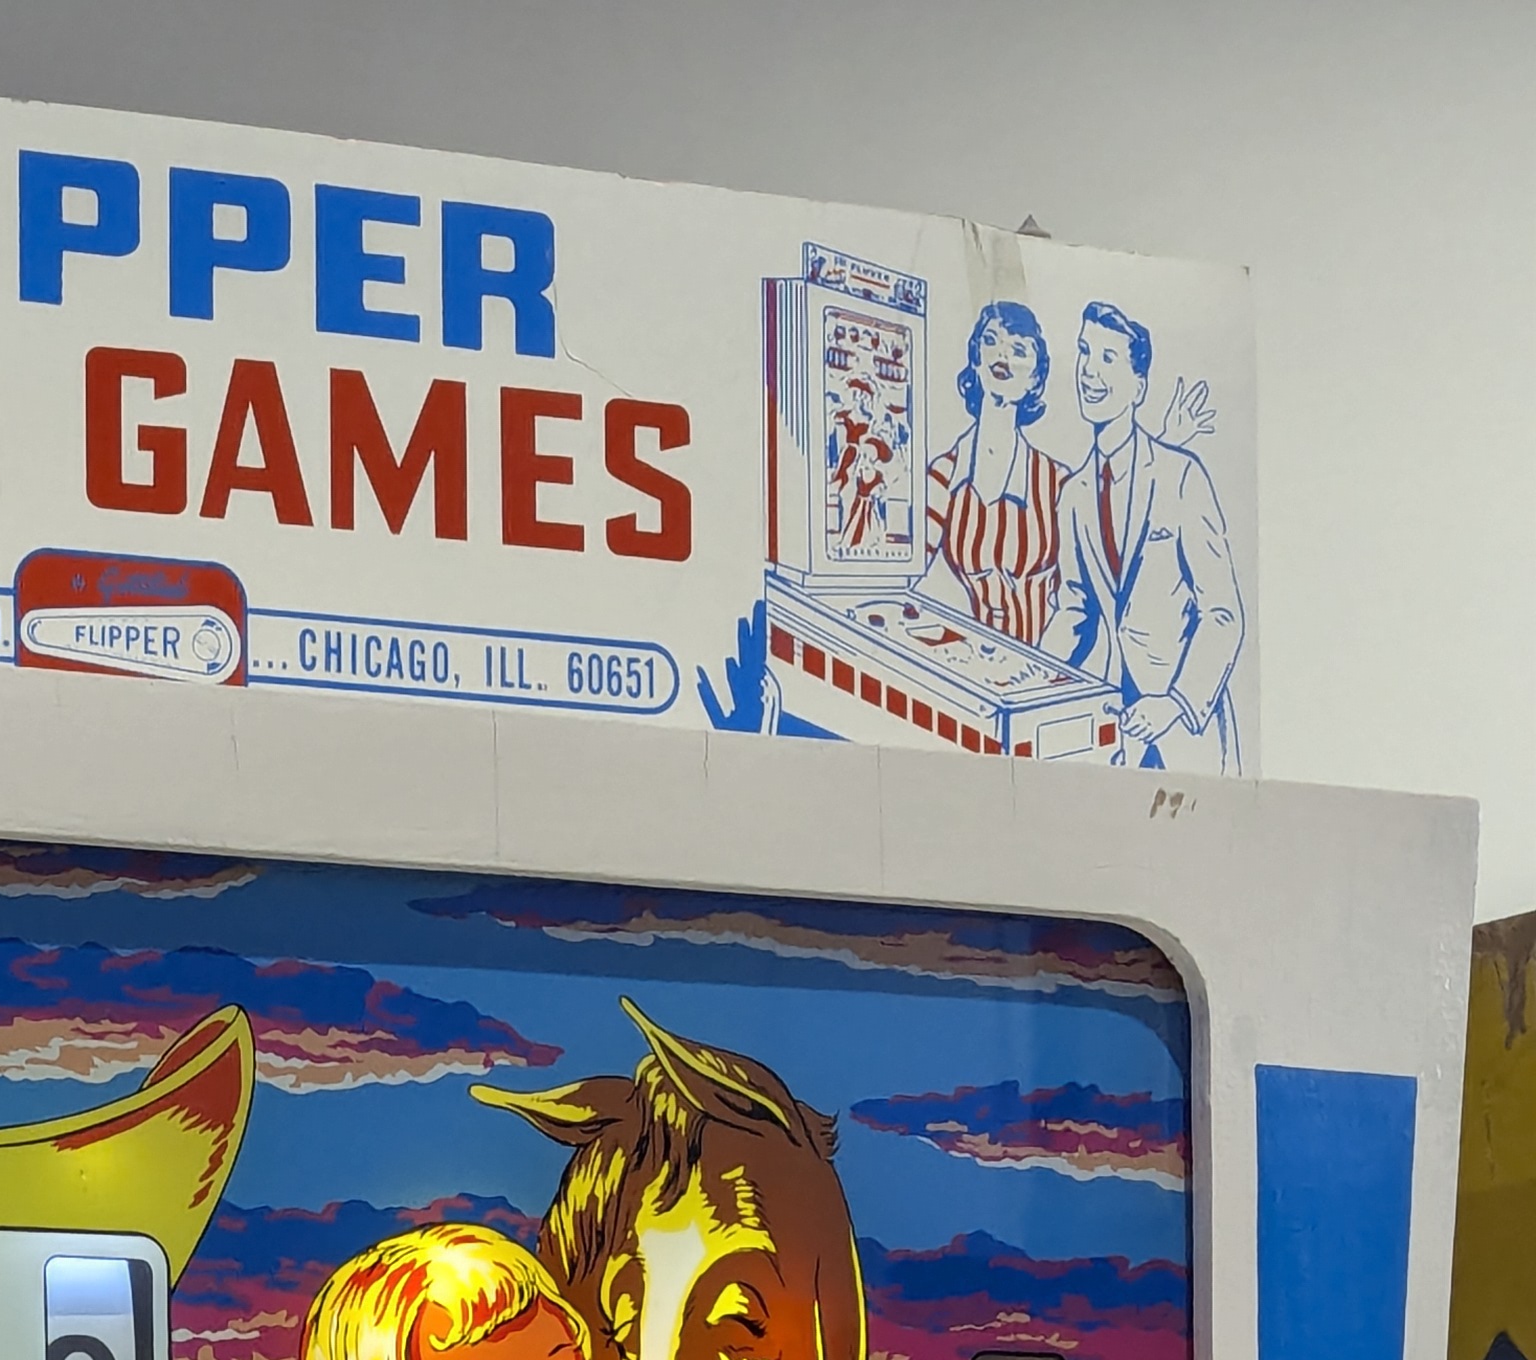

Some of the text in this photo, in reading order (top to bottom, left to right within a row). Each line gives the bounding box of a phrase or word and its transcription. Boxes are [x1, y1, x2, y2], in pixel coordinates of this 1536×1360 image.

[85, 345, 692, 563] GAMES
[75, 625, 181, 660] FLIPPER
[567, 651, 655, 699] 60651
